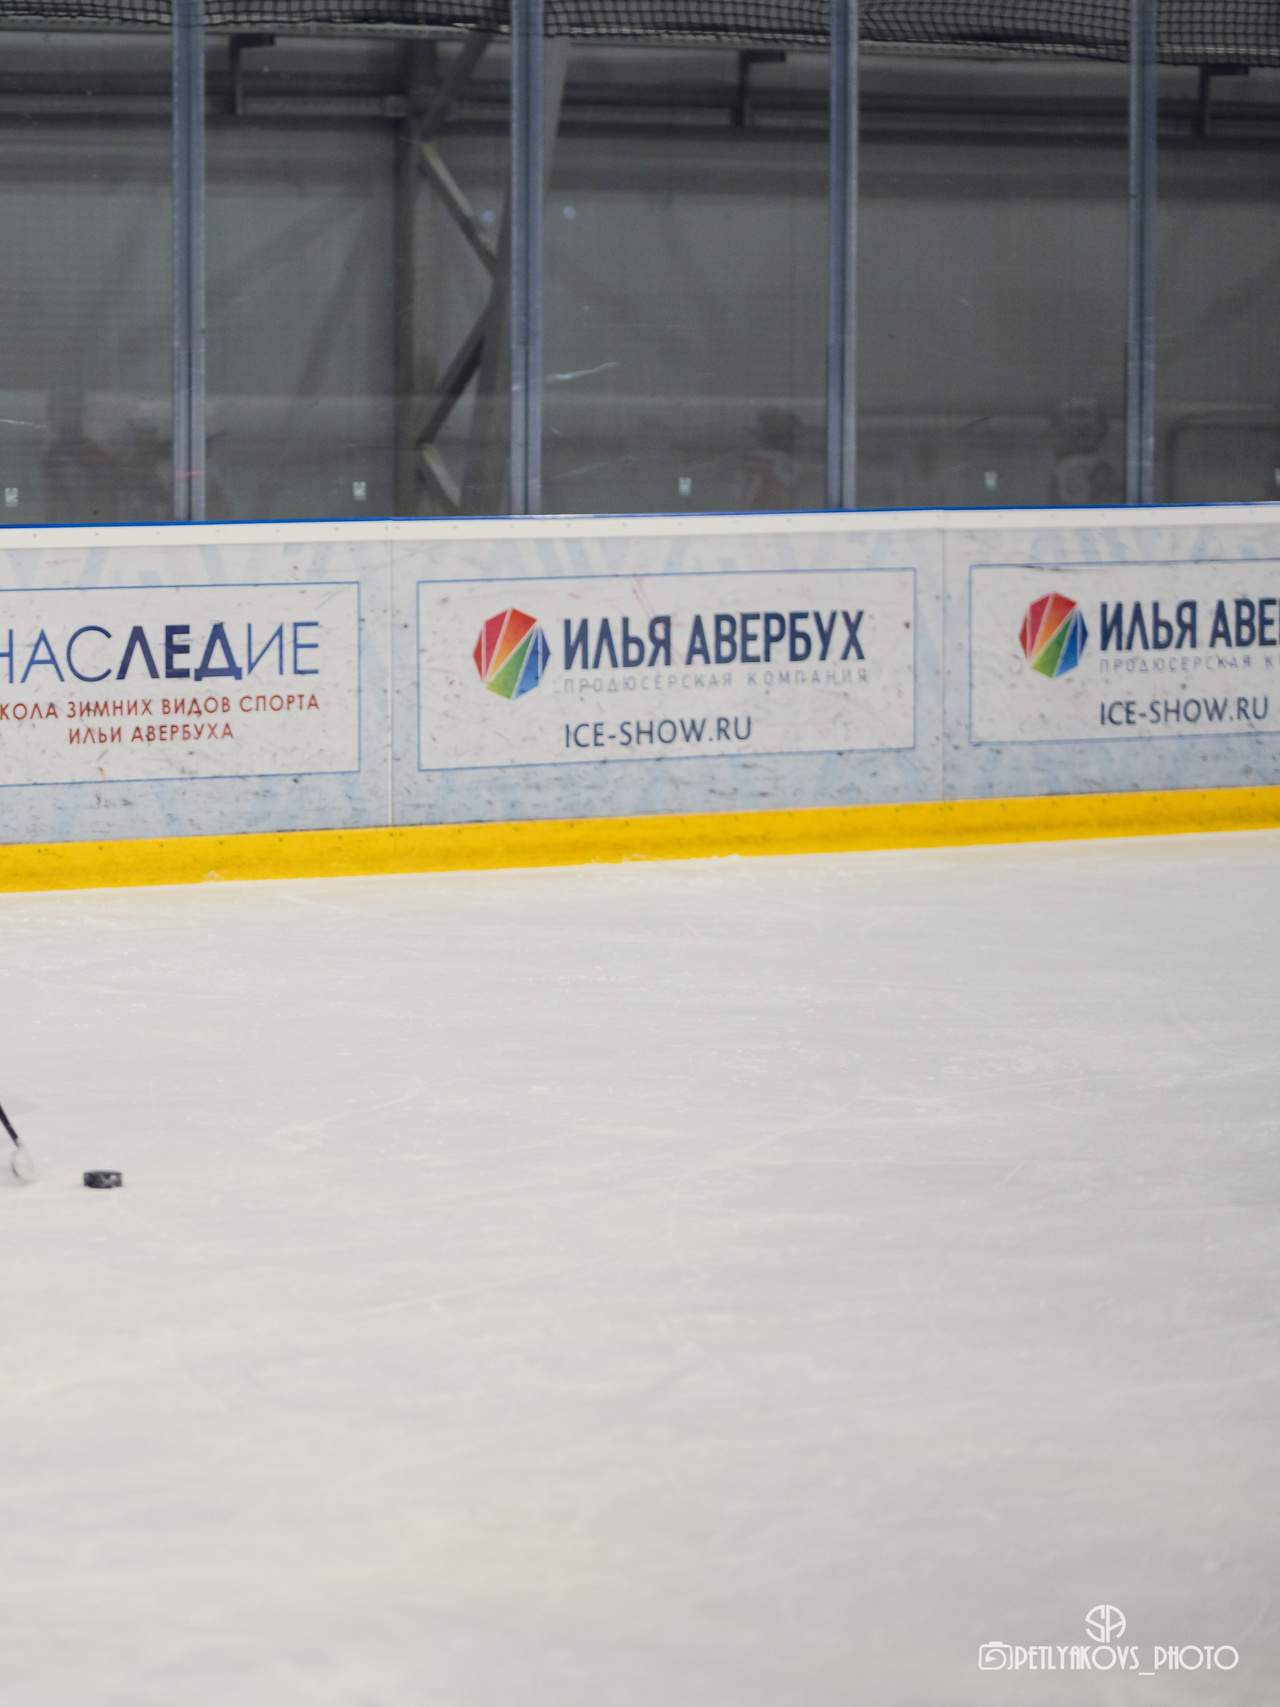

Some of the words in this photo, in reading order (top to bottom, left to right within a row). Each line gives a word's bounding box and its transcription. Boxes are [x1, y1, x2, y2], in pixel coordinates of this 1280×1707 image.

[1100, 600, 1197, 651] ИЛЬЯ
[1208, 597, 1280, 648] АВЕ
[563, 615, 671, 670] ИЛЬЯ
[685, 609, 866, 666] АВЕРБУХ
[1100, 654, 1252, 673] ПРОДЮСЕРСКАЯ
[564, 671, 733, 693] ПРОДЮСЕРСКАЯ
[747, 667, 868, 687] КОМПАНИЯ
[67, 699, 153, 719] ЗИМНИХ
[162, 697, 231, 716] ВИДОВ
[239, 694, 320, 713] СПОРТА
[1100, 695, 1268, 725] ICE-SHOW.RU
[69, 727, 122, 744] ИЛЬИ
[131, 723, 234, 742] АВЕРБУХА
[564, 716, 752, 748] ICE-SHOW.RU
